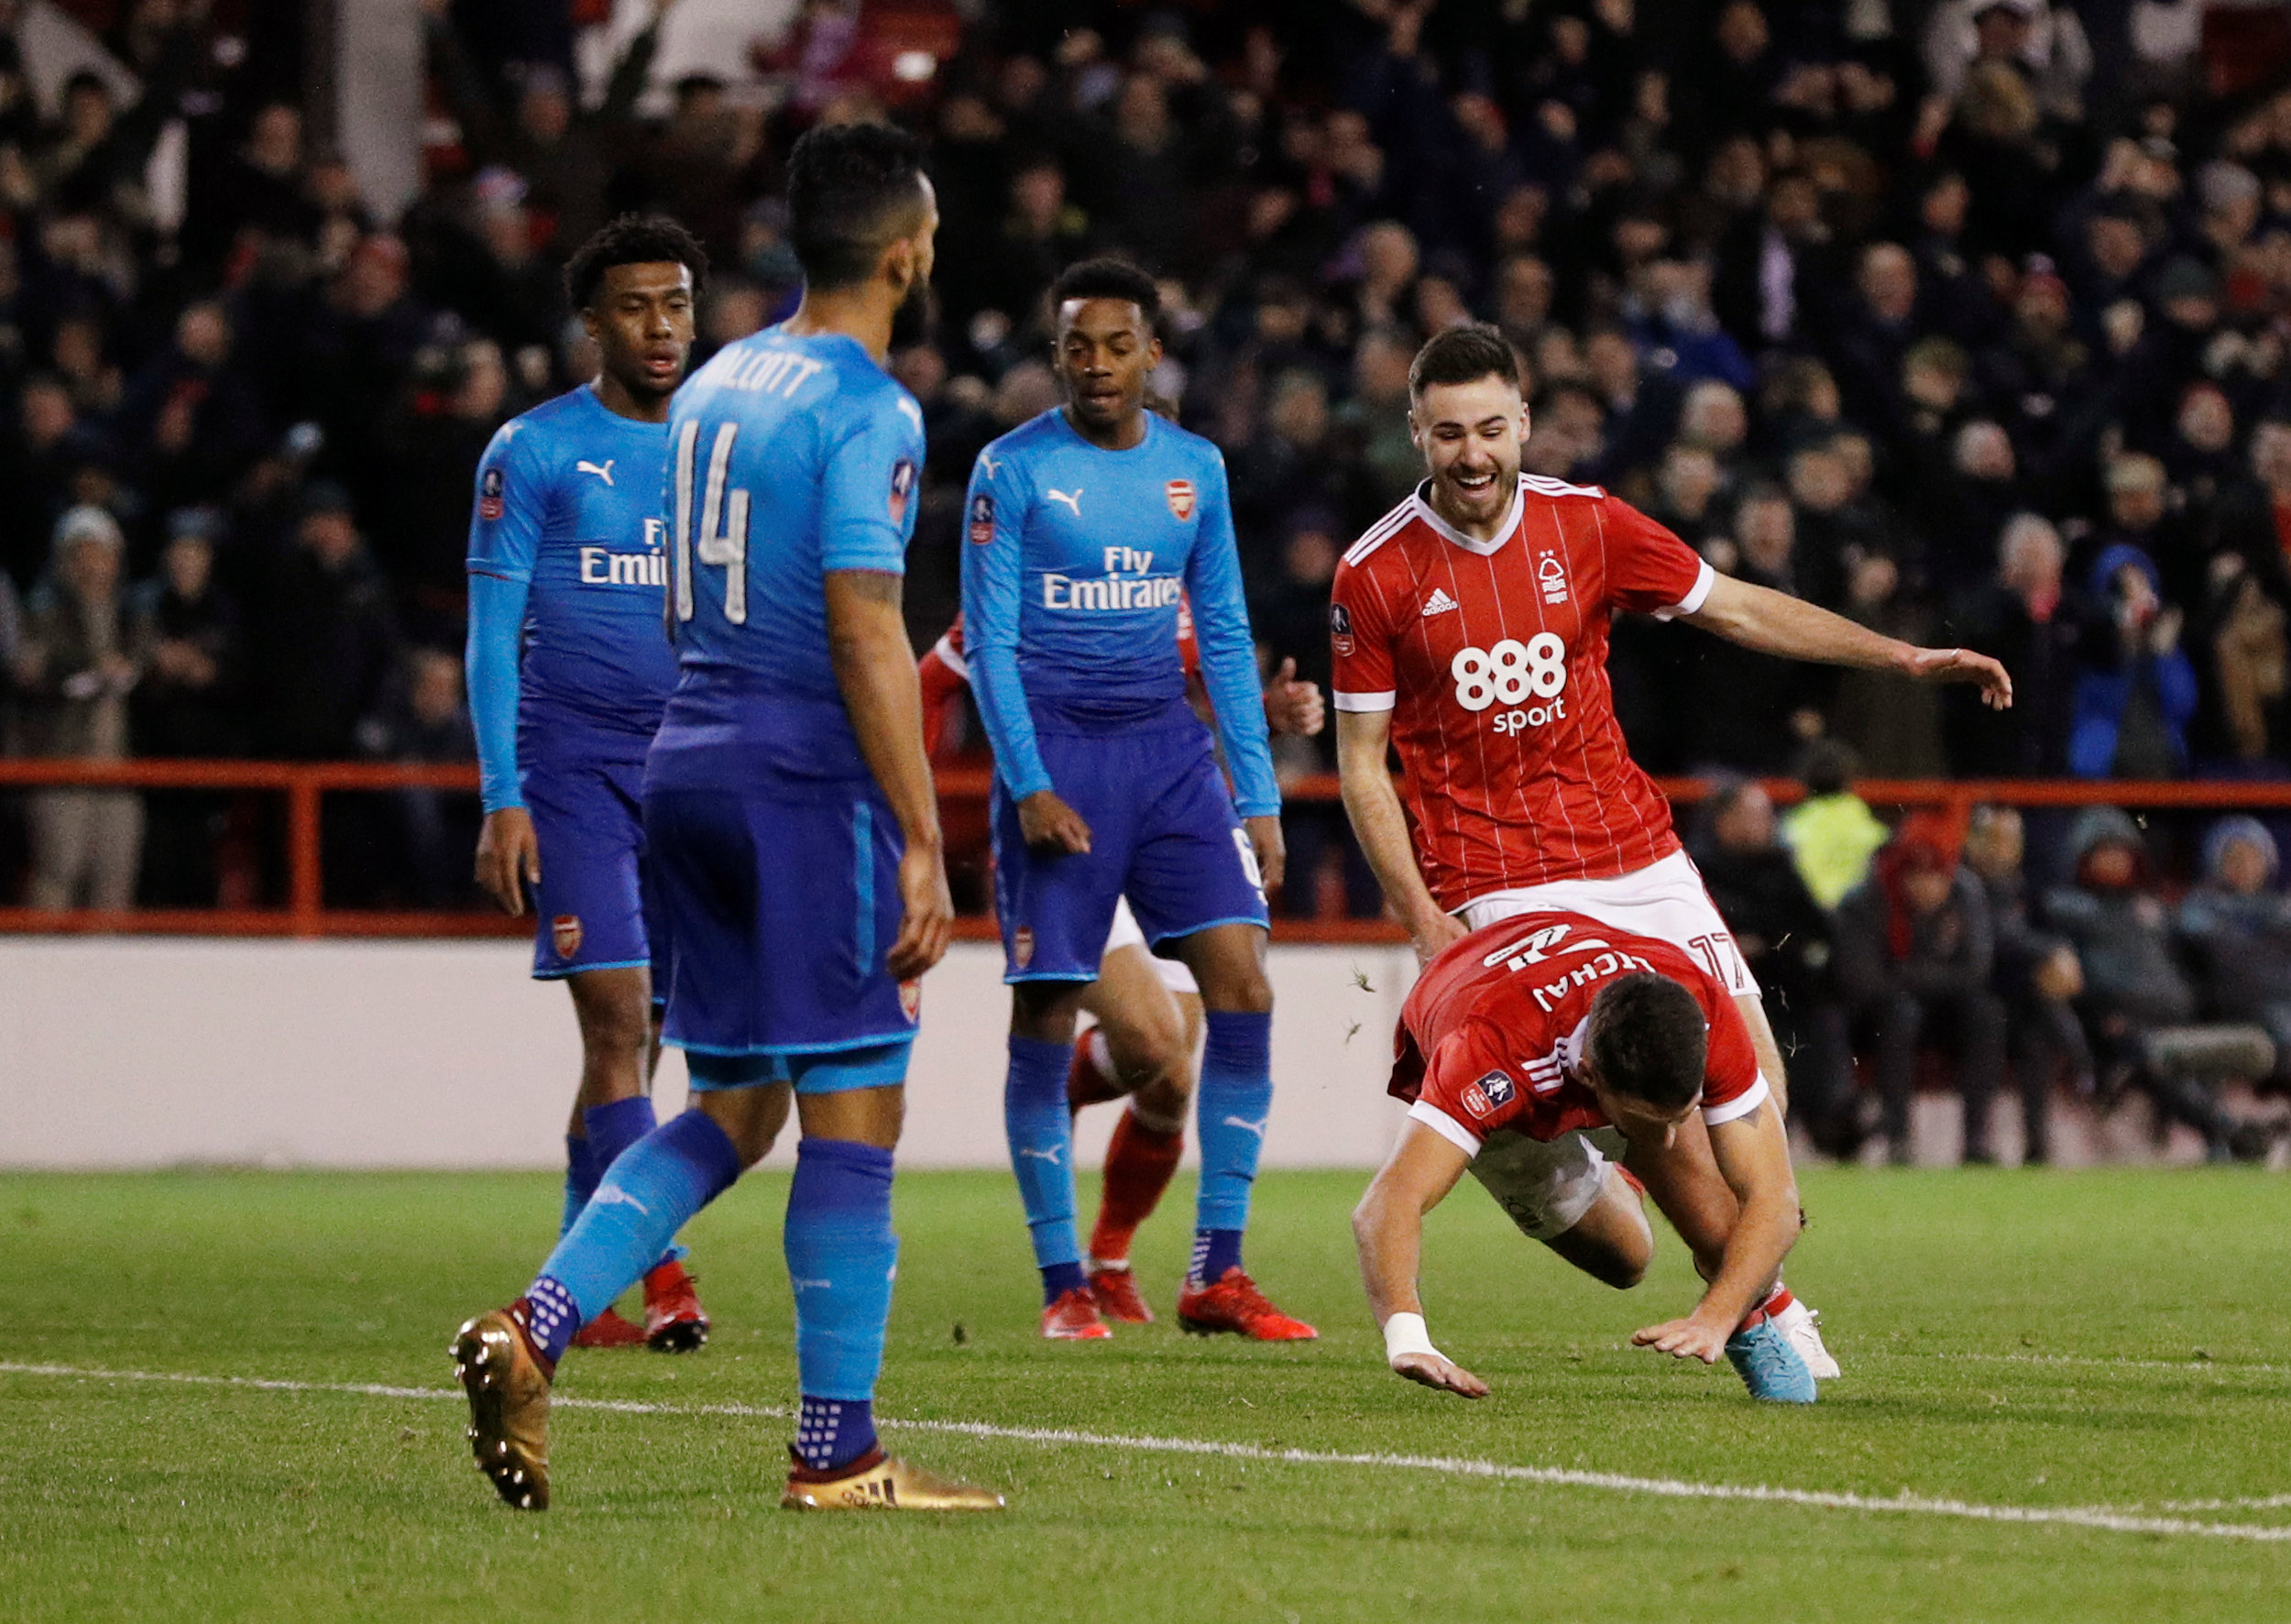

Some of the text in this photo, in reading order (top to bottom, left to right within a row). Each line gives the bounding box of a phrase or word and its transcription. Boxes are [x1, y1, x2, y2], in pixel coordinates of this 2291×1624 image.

[676, 420, 750, 625] 14
[1104, 546, 1154, 576] Fly
[1451, 631, 1567, 711] 888
[1493, 697, 1566, 737] sport
[1688, 932, 1745, 992] 17
